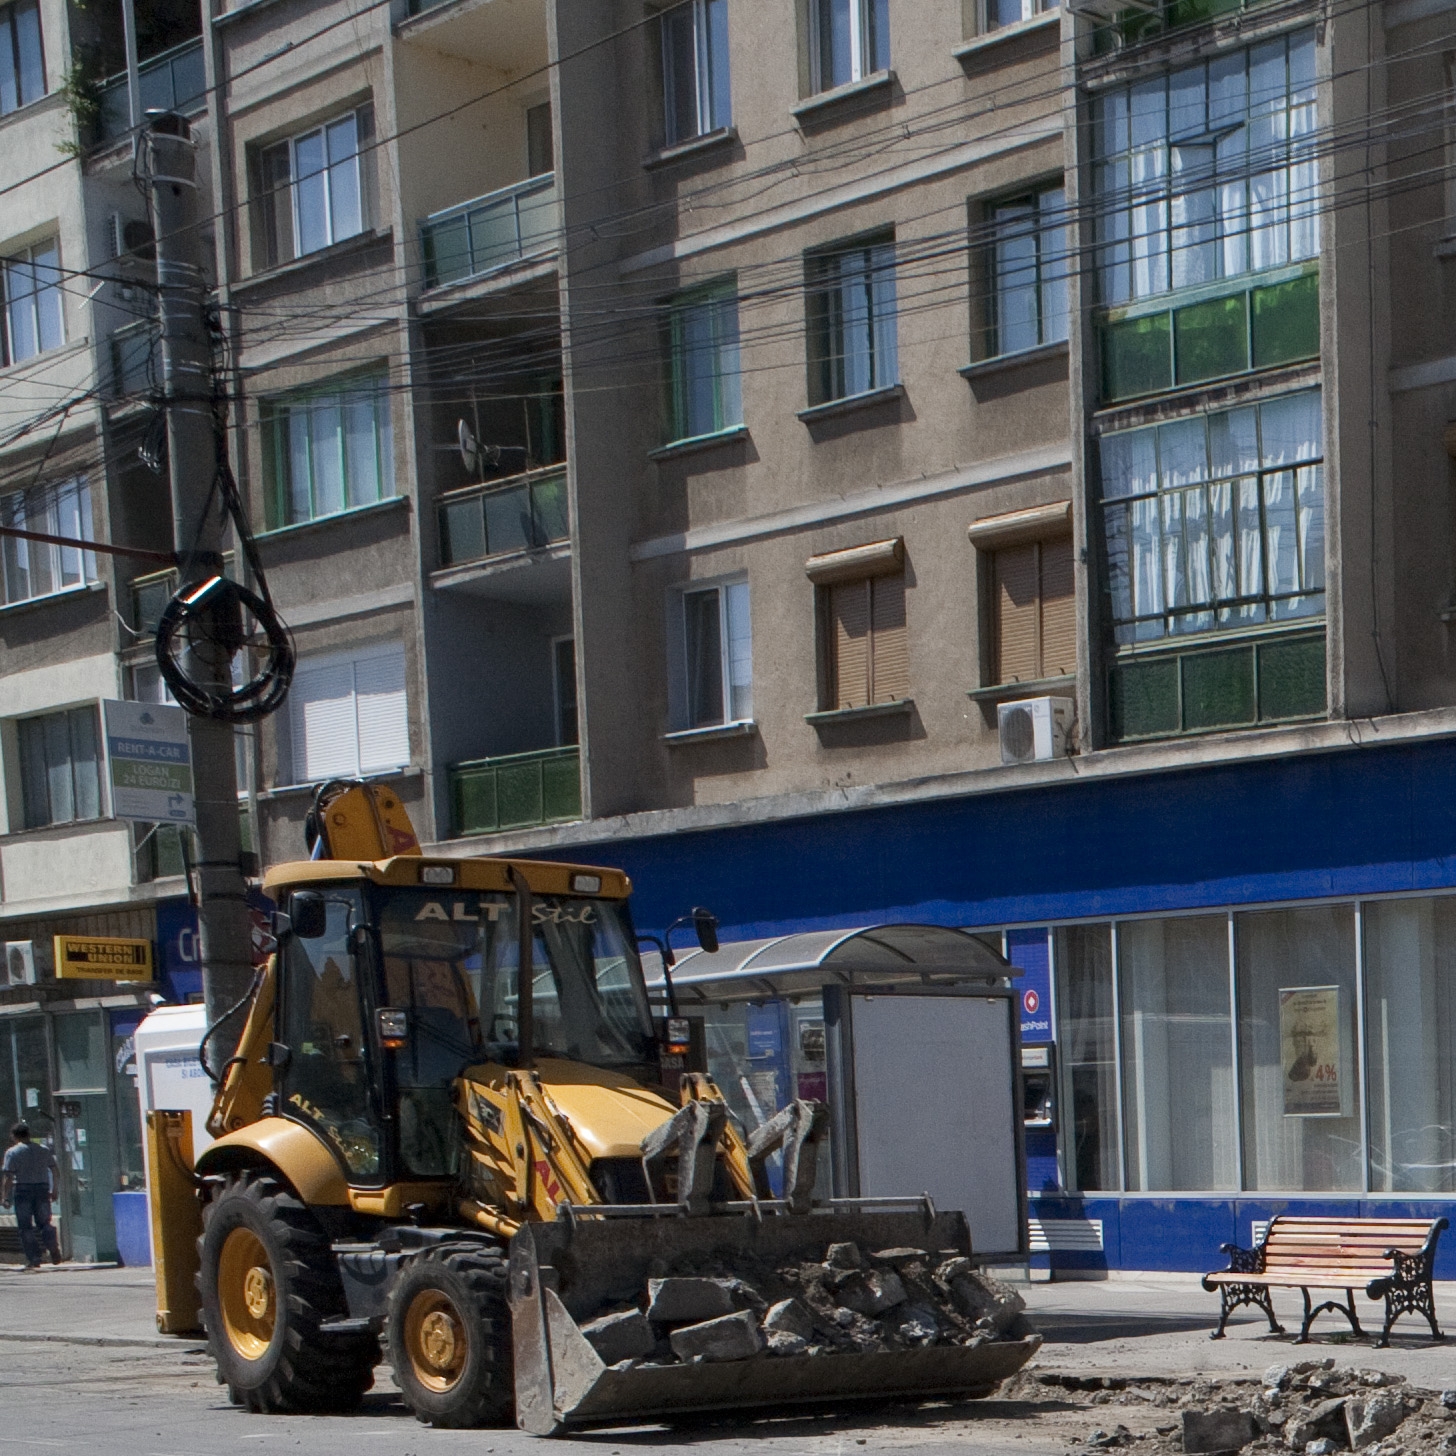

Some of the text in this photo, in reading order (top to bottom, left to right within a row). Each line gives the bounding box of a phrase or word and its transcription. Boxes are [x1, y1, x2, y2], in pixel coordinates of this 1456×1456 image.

[117, 742, 180, 758] RENT-A-CAR
[134, 764, 169, 776] LOGAN
[414, 902, 597, 924] ALT Stil
[67, 943, 133, 955] WESTERN
[87, 953, 133, 963] UNION
[288, 1093, 326, 1120] ALT
